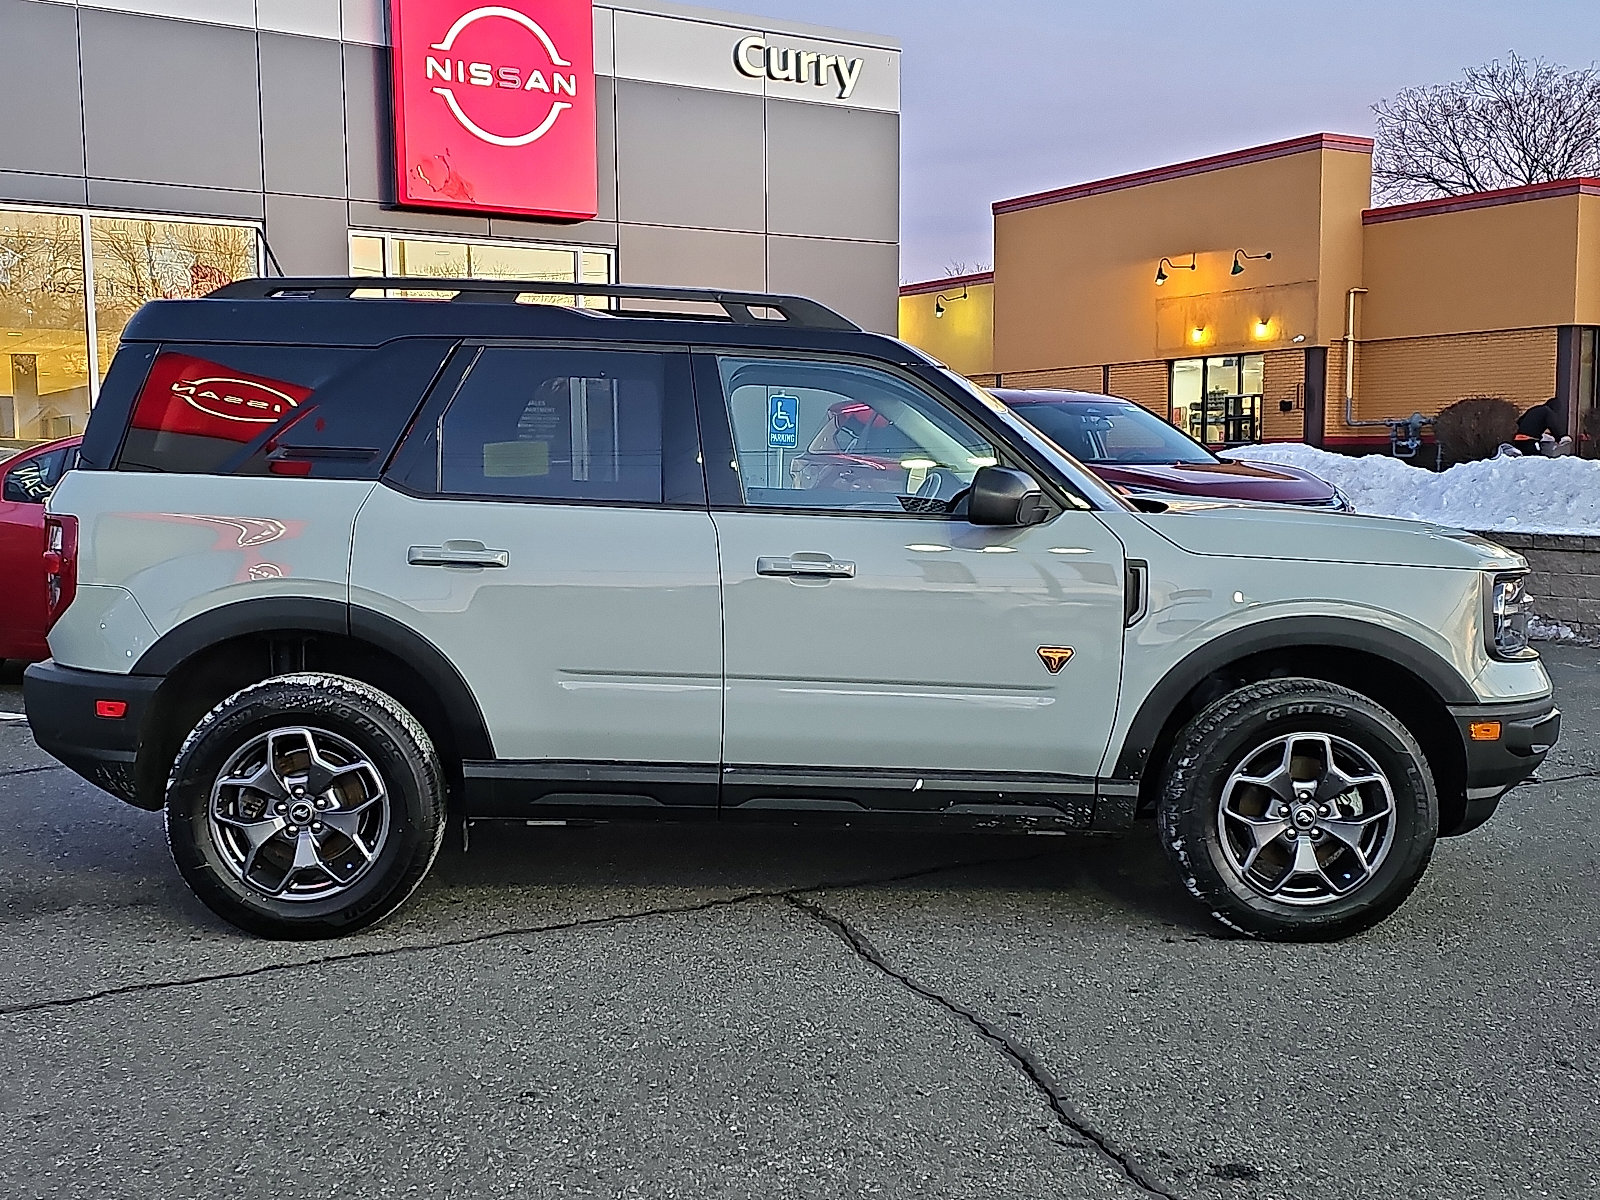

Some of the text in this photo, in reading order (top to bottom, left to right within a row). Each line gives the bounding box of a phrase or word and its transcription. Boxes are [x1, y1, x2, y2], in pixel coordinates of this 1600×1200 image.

[425, 55, 577, 97] NISSAN
[732, 36, 864, 99] Curry
[770, 433, 795, 443] PARKING
[1266, 708, 1281, 721] G
[1287, 704, 1318, 715] FIT
